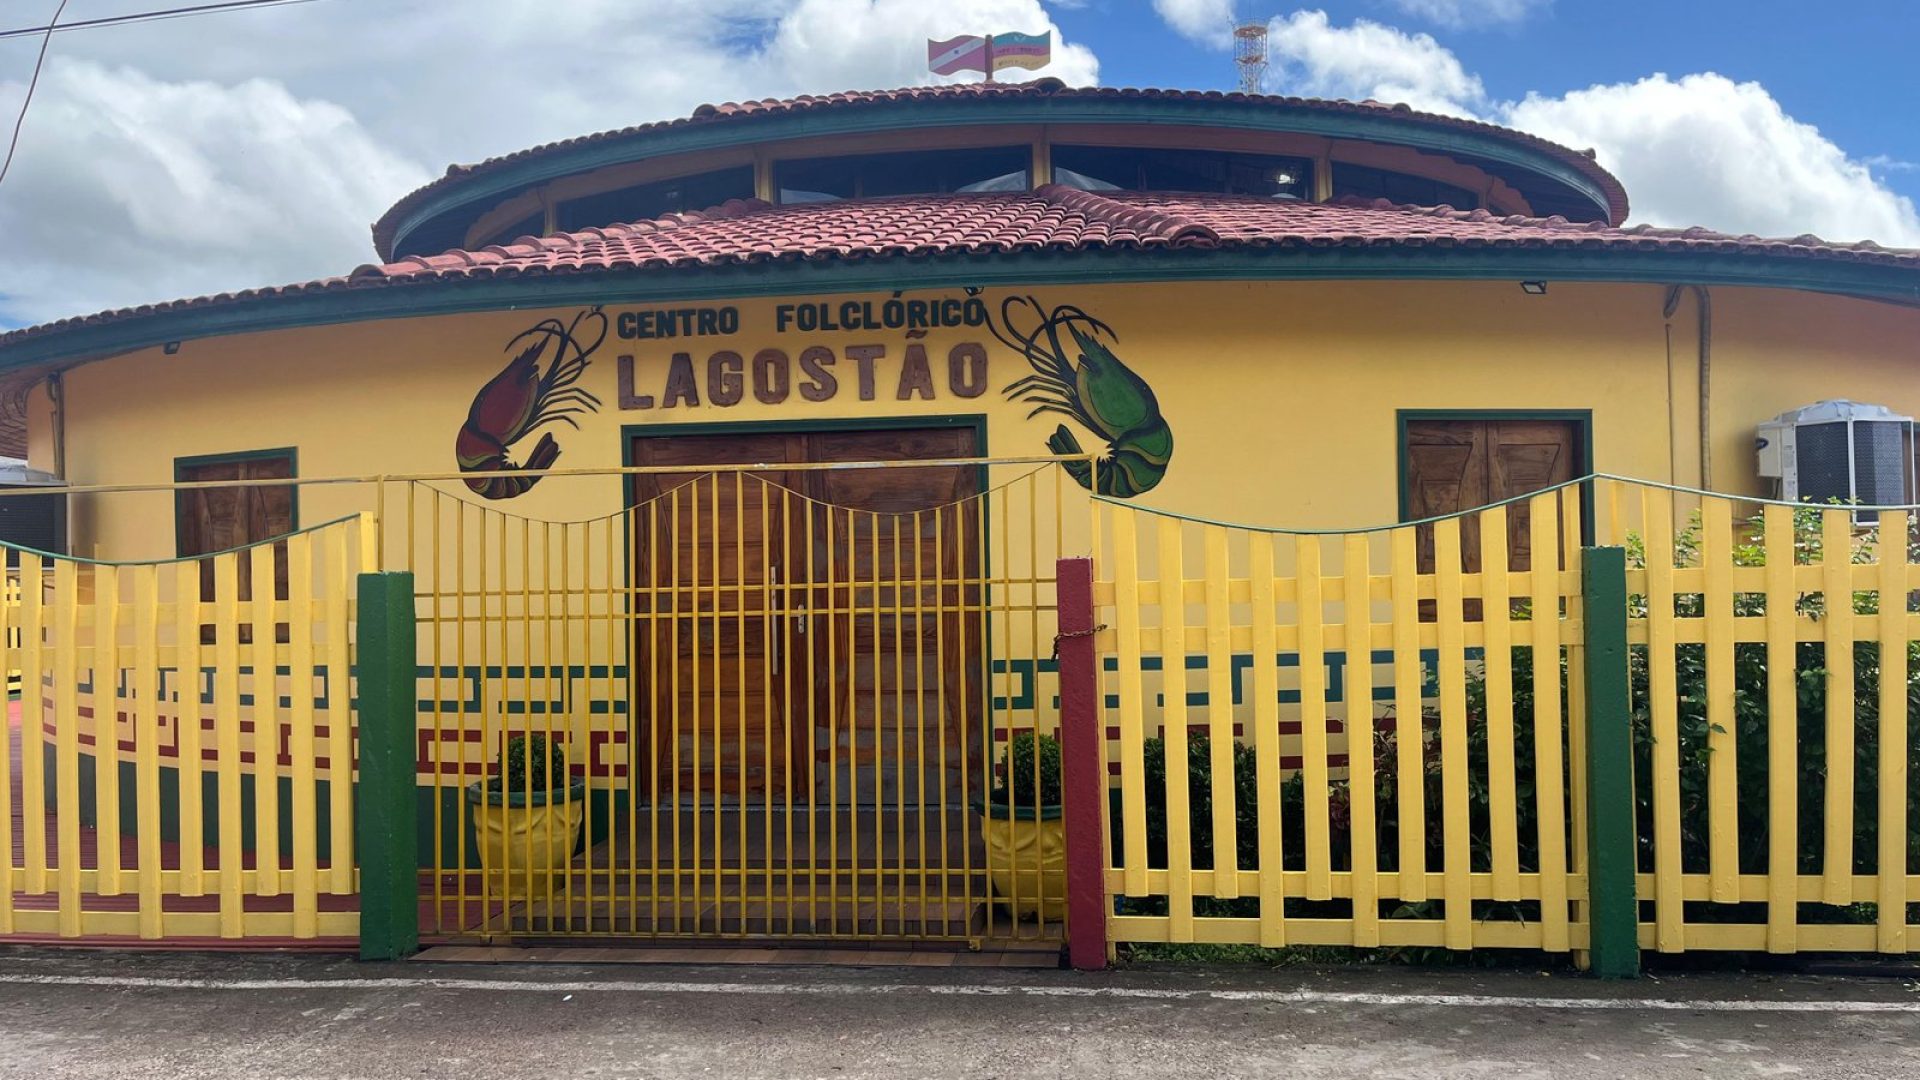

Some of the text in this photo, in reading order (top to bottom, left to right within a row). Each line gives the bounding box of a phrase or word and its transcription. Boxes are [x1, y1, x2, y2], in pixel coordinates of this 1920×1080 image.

[618, 291, 984, 339] CENTRO FOLCLÓRICO
[617, 329, 988, 410] LAGOSTÃO
